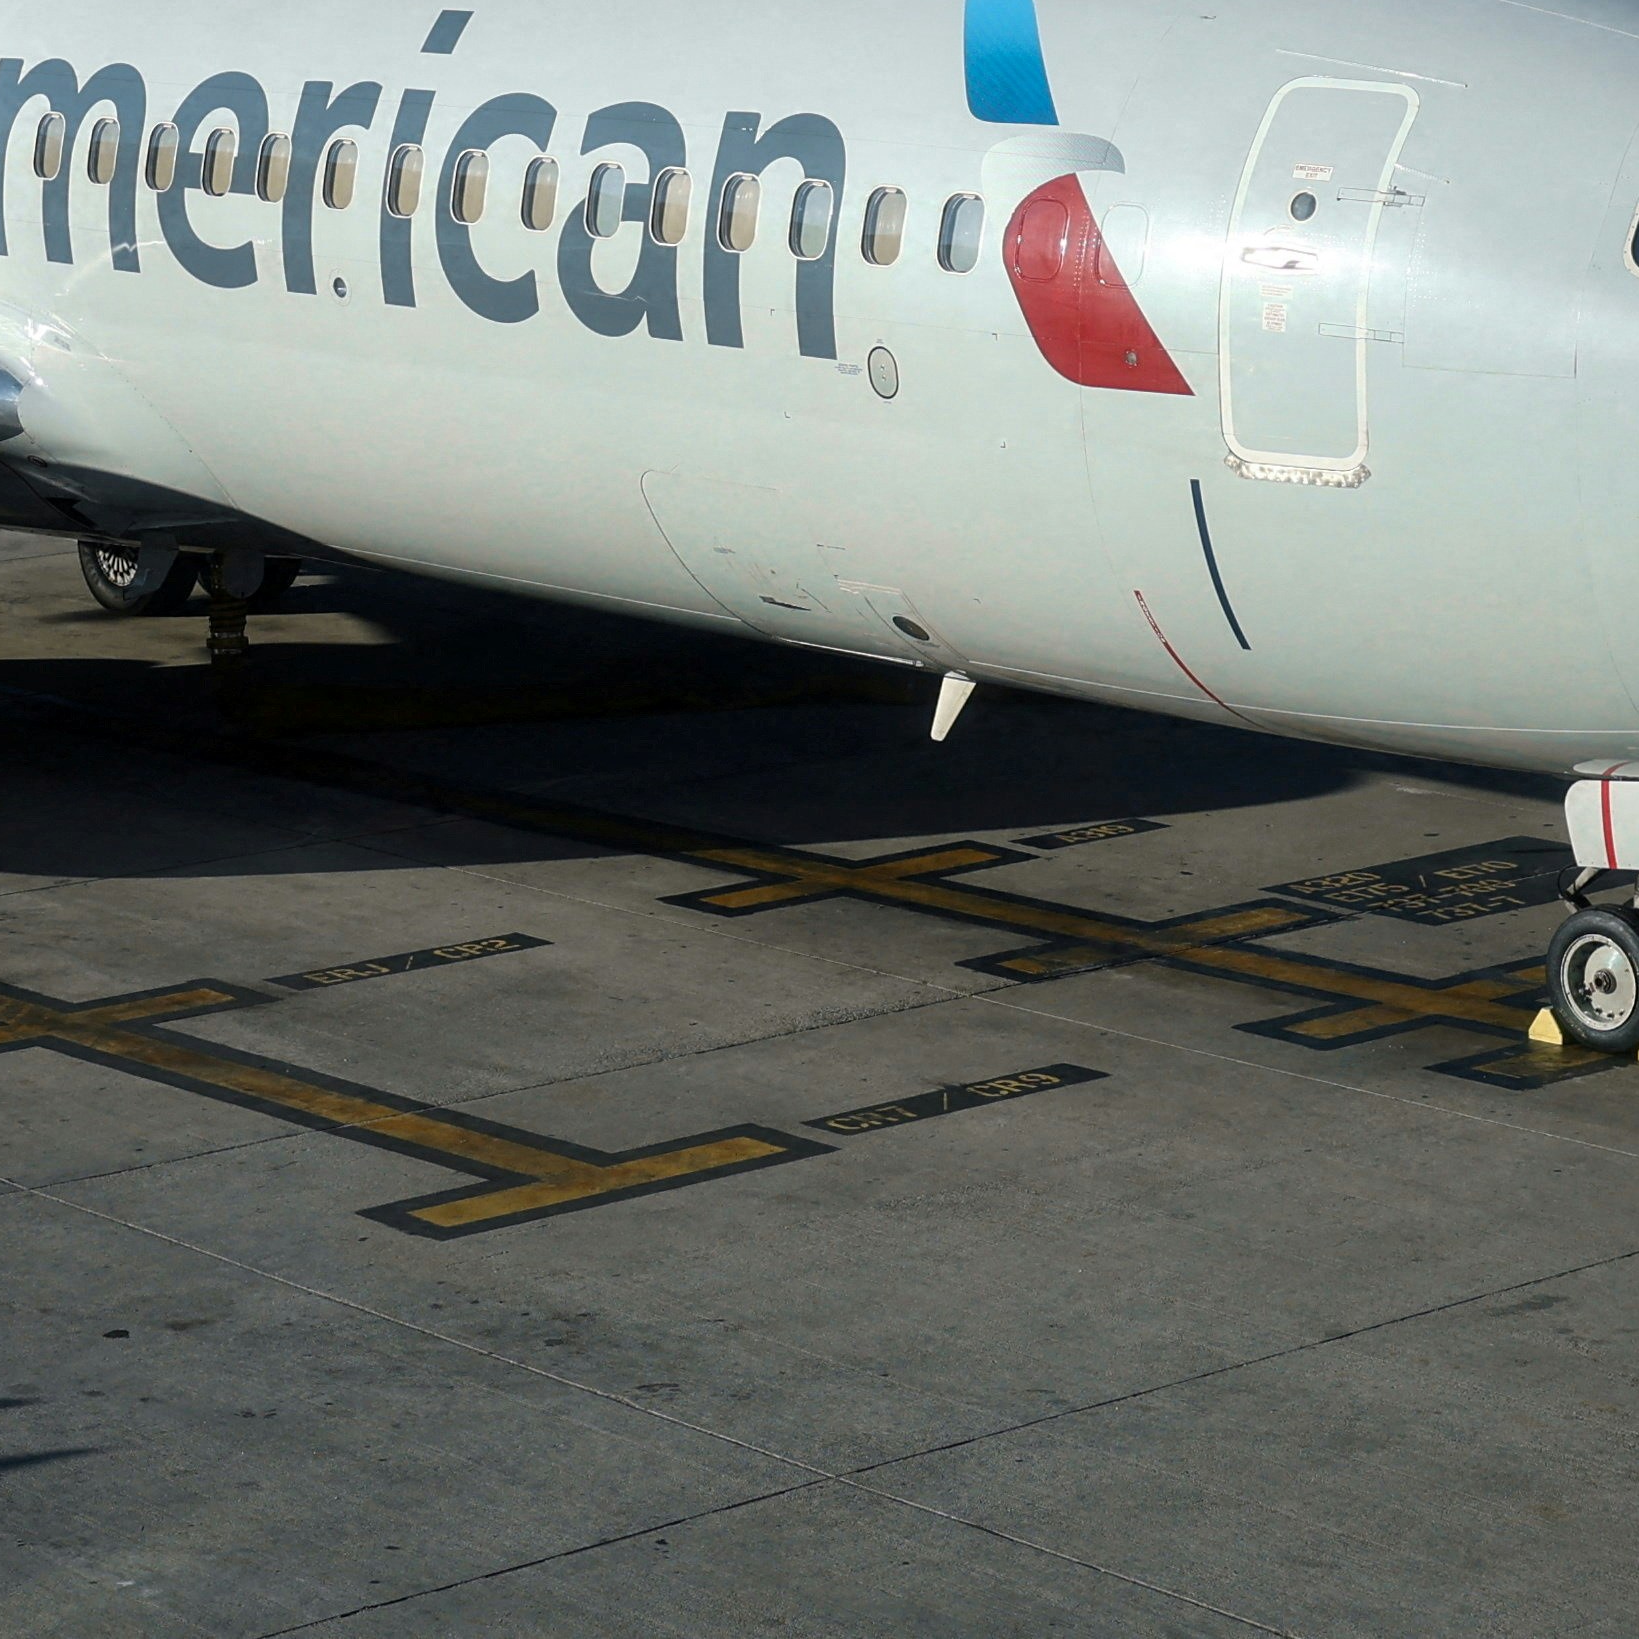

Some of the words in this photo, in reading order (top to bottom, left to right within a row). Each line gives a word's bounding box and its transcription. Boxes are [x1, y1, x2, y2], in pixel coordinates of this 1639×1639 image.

[304, 963, 391, 985] ERJ
[433, 939, 520, 959] CR2
[965, 1073, 1062, 1098] CR9
